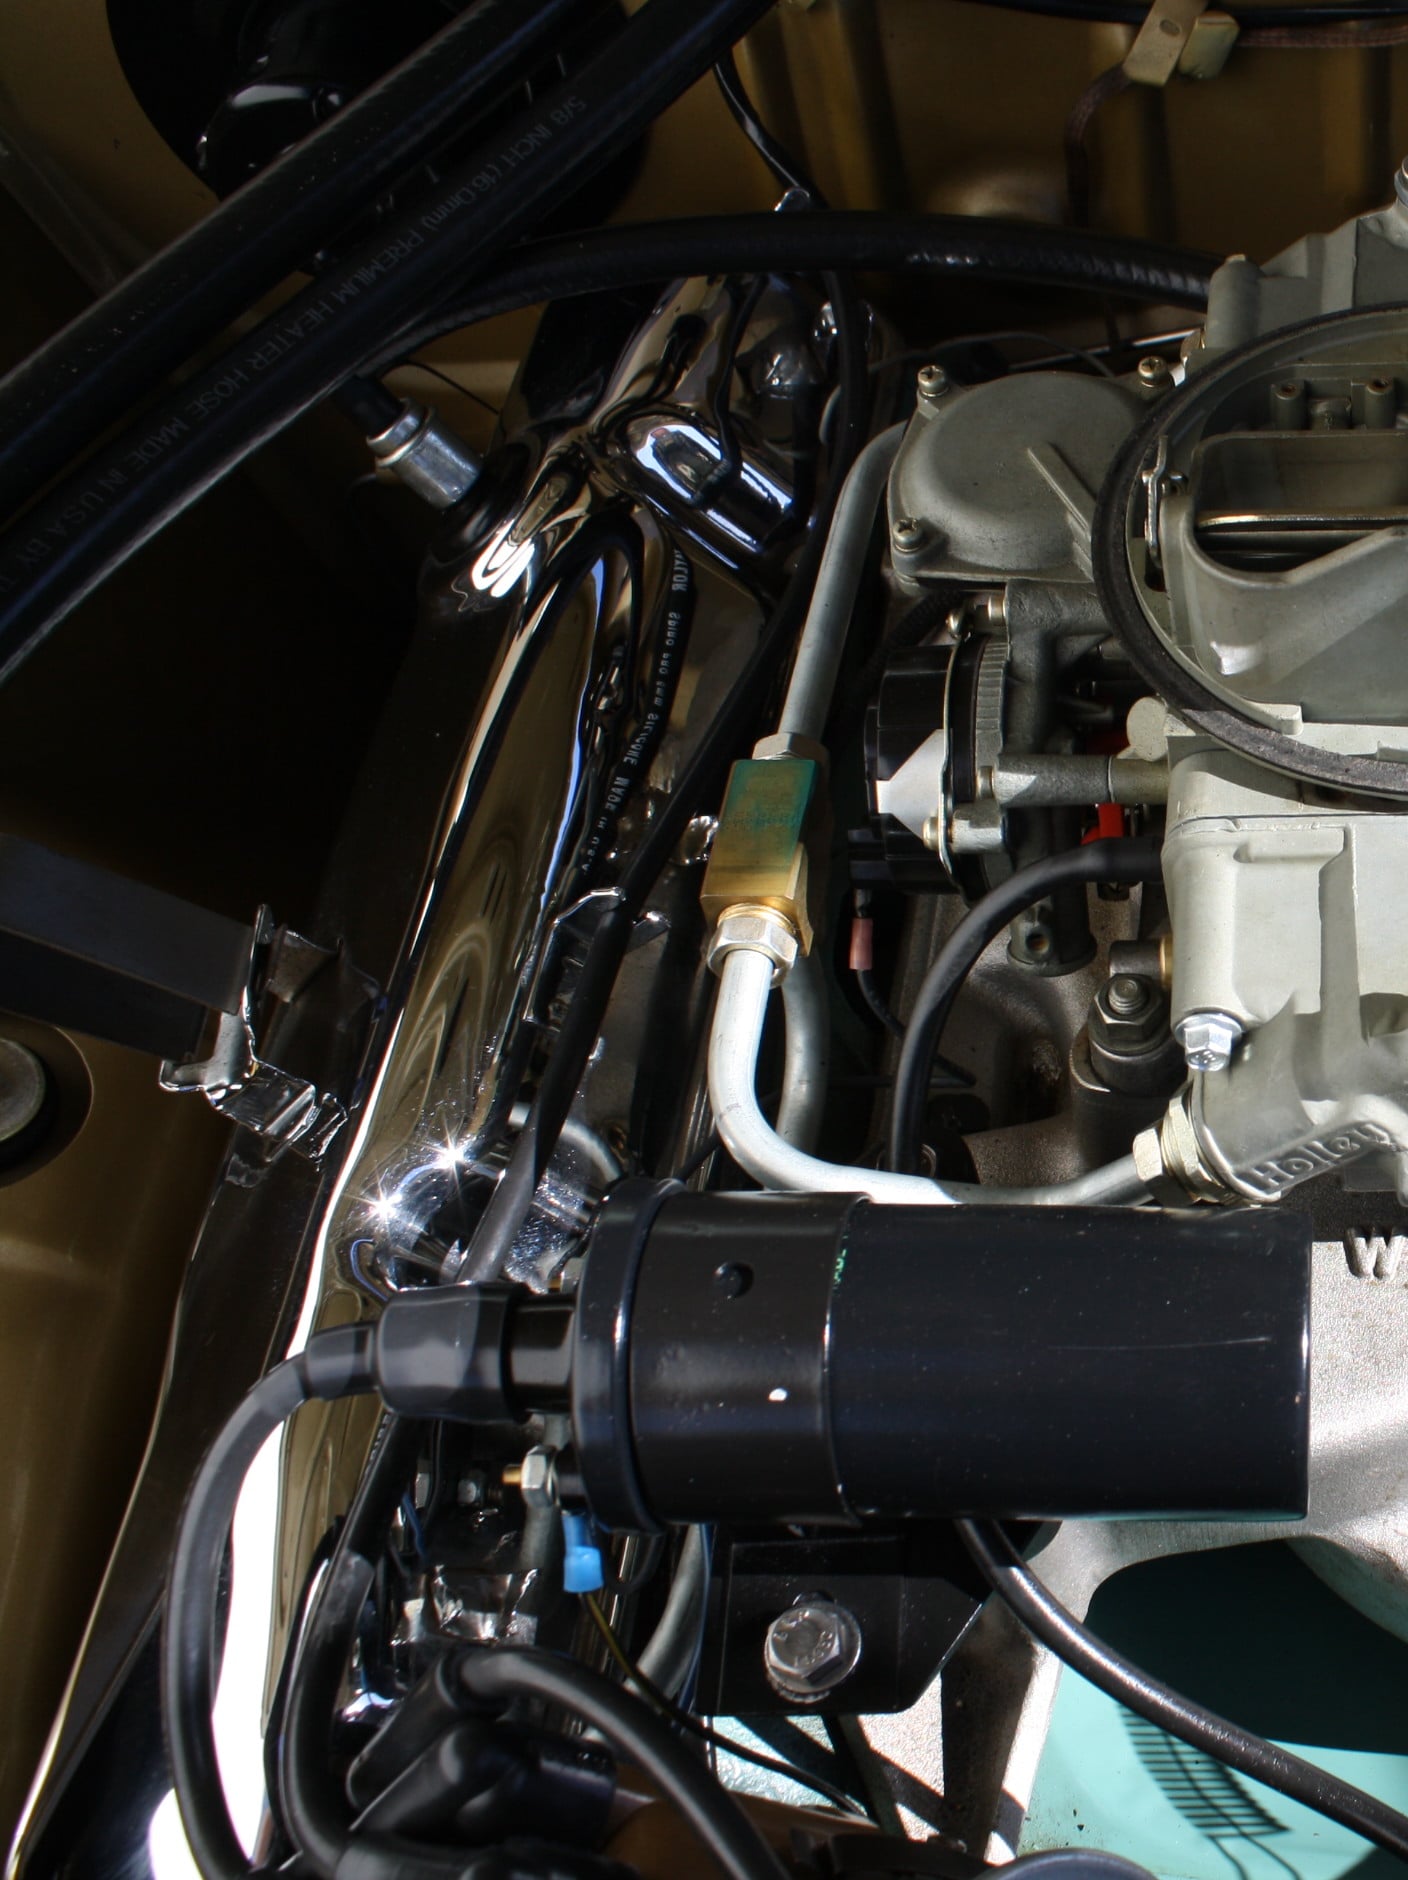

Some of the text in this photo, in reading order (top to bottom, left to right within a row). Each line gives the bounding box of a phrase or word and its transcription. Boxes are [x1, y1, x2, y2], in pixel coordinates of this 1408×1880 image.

[550, 96, 587, 125] 5/8
[501, 123, 553, 168] INCH
[330, 229, 425, 304] PREMIUM
[246, 300, 335, 370] HEATER
[185, 367, 250, 421] HOSE
[124, 416, 190, 472] MADE
[97, 467, 129, 492] IN
[16, 538, 52, 572] BY
[1249, 1123, 1395, 1187] Holley
